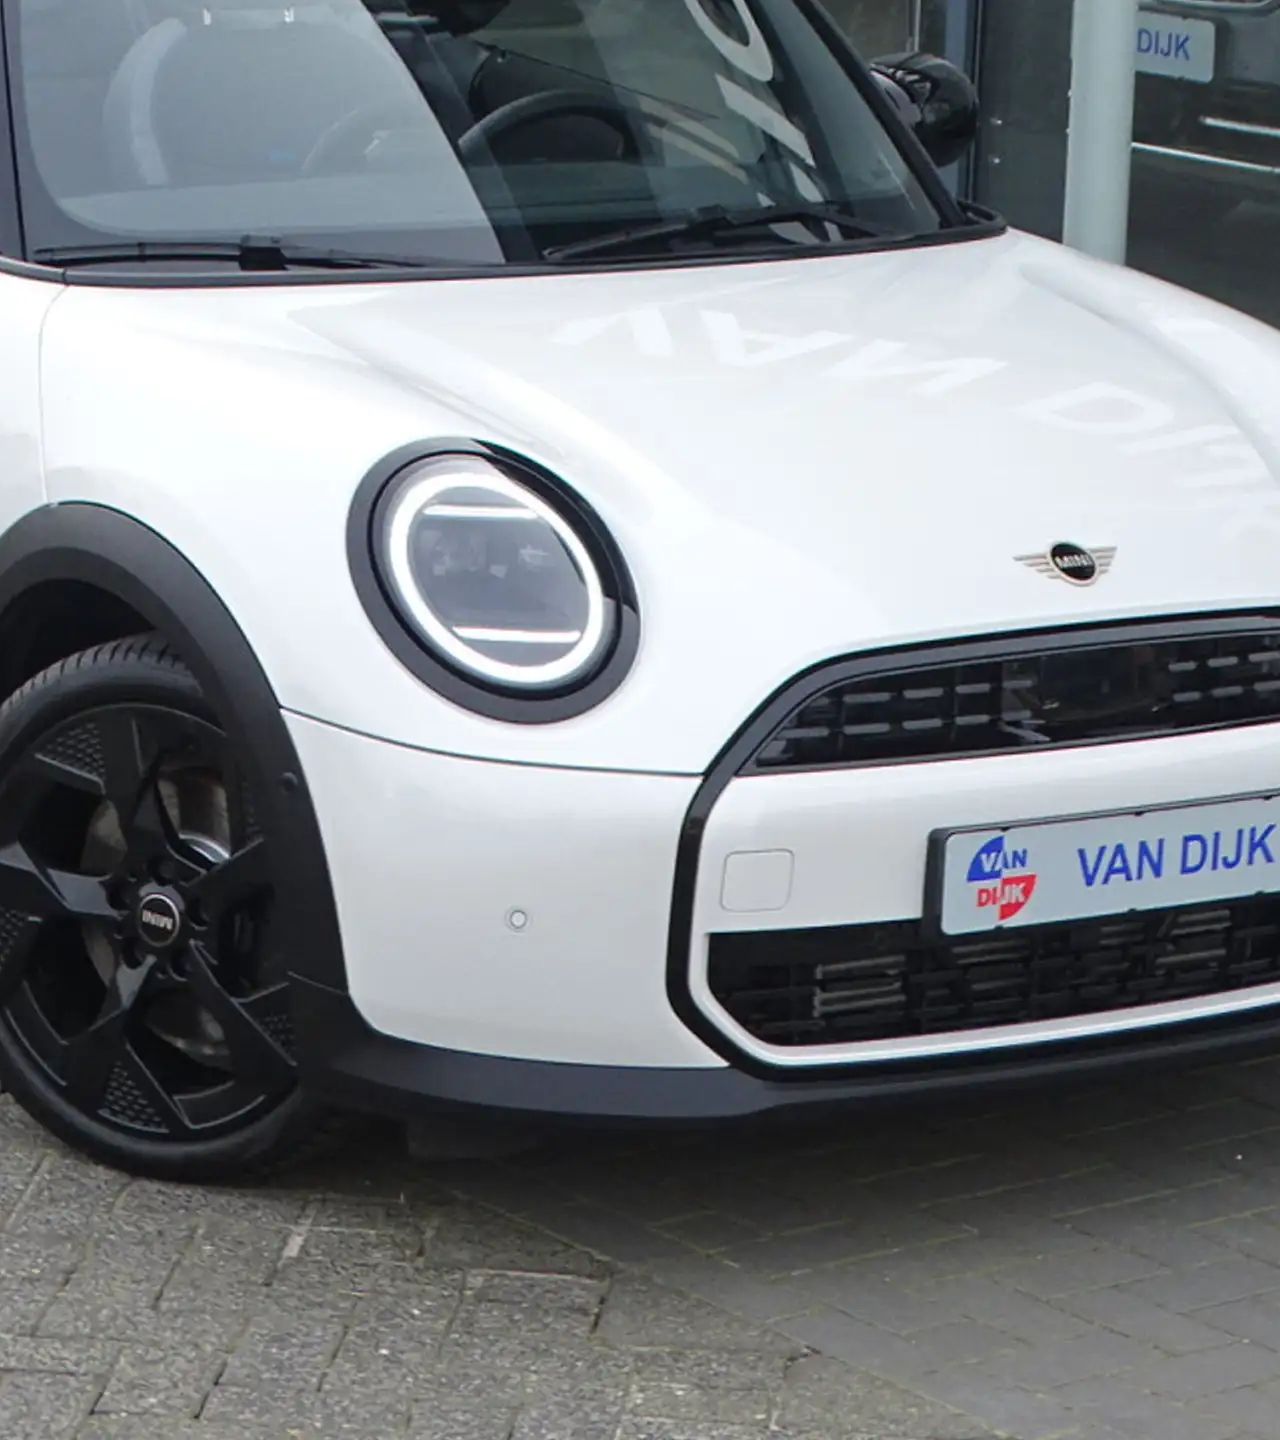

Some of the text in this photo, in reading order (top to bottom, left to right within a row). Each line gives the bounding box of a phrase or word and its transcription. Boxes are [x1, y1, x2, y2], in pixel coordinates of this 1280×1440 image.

[1137, 28, 1191, 61] DIJK
[1055, 554, 1092, 568] MINI
[980, 847, 1028, 873] VAN
[1076, 823, 1277, 888] VAN DIJK
[976, 882, 1027, 908] DIJK
[142, 909, 173, 931] MINI
